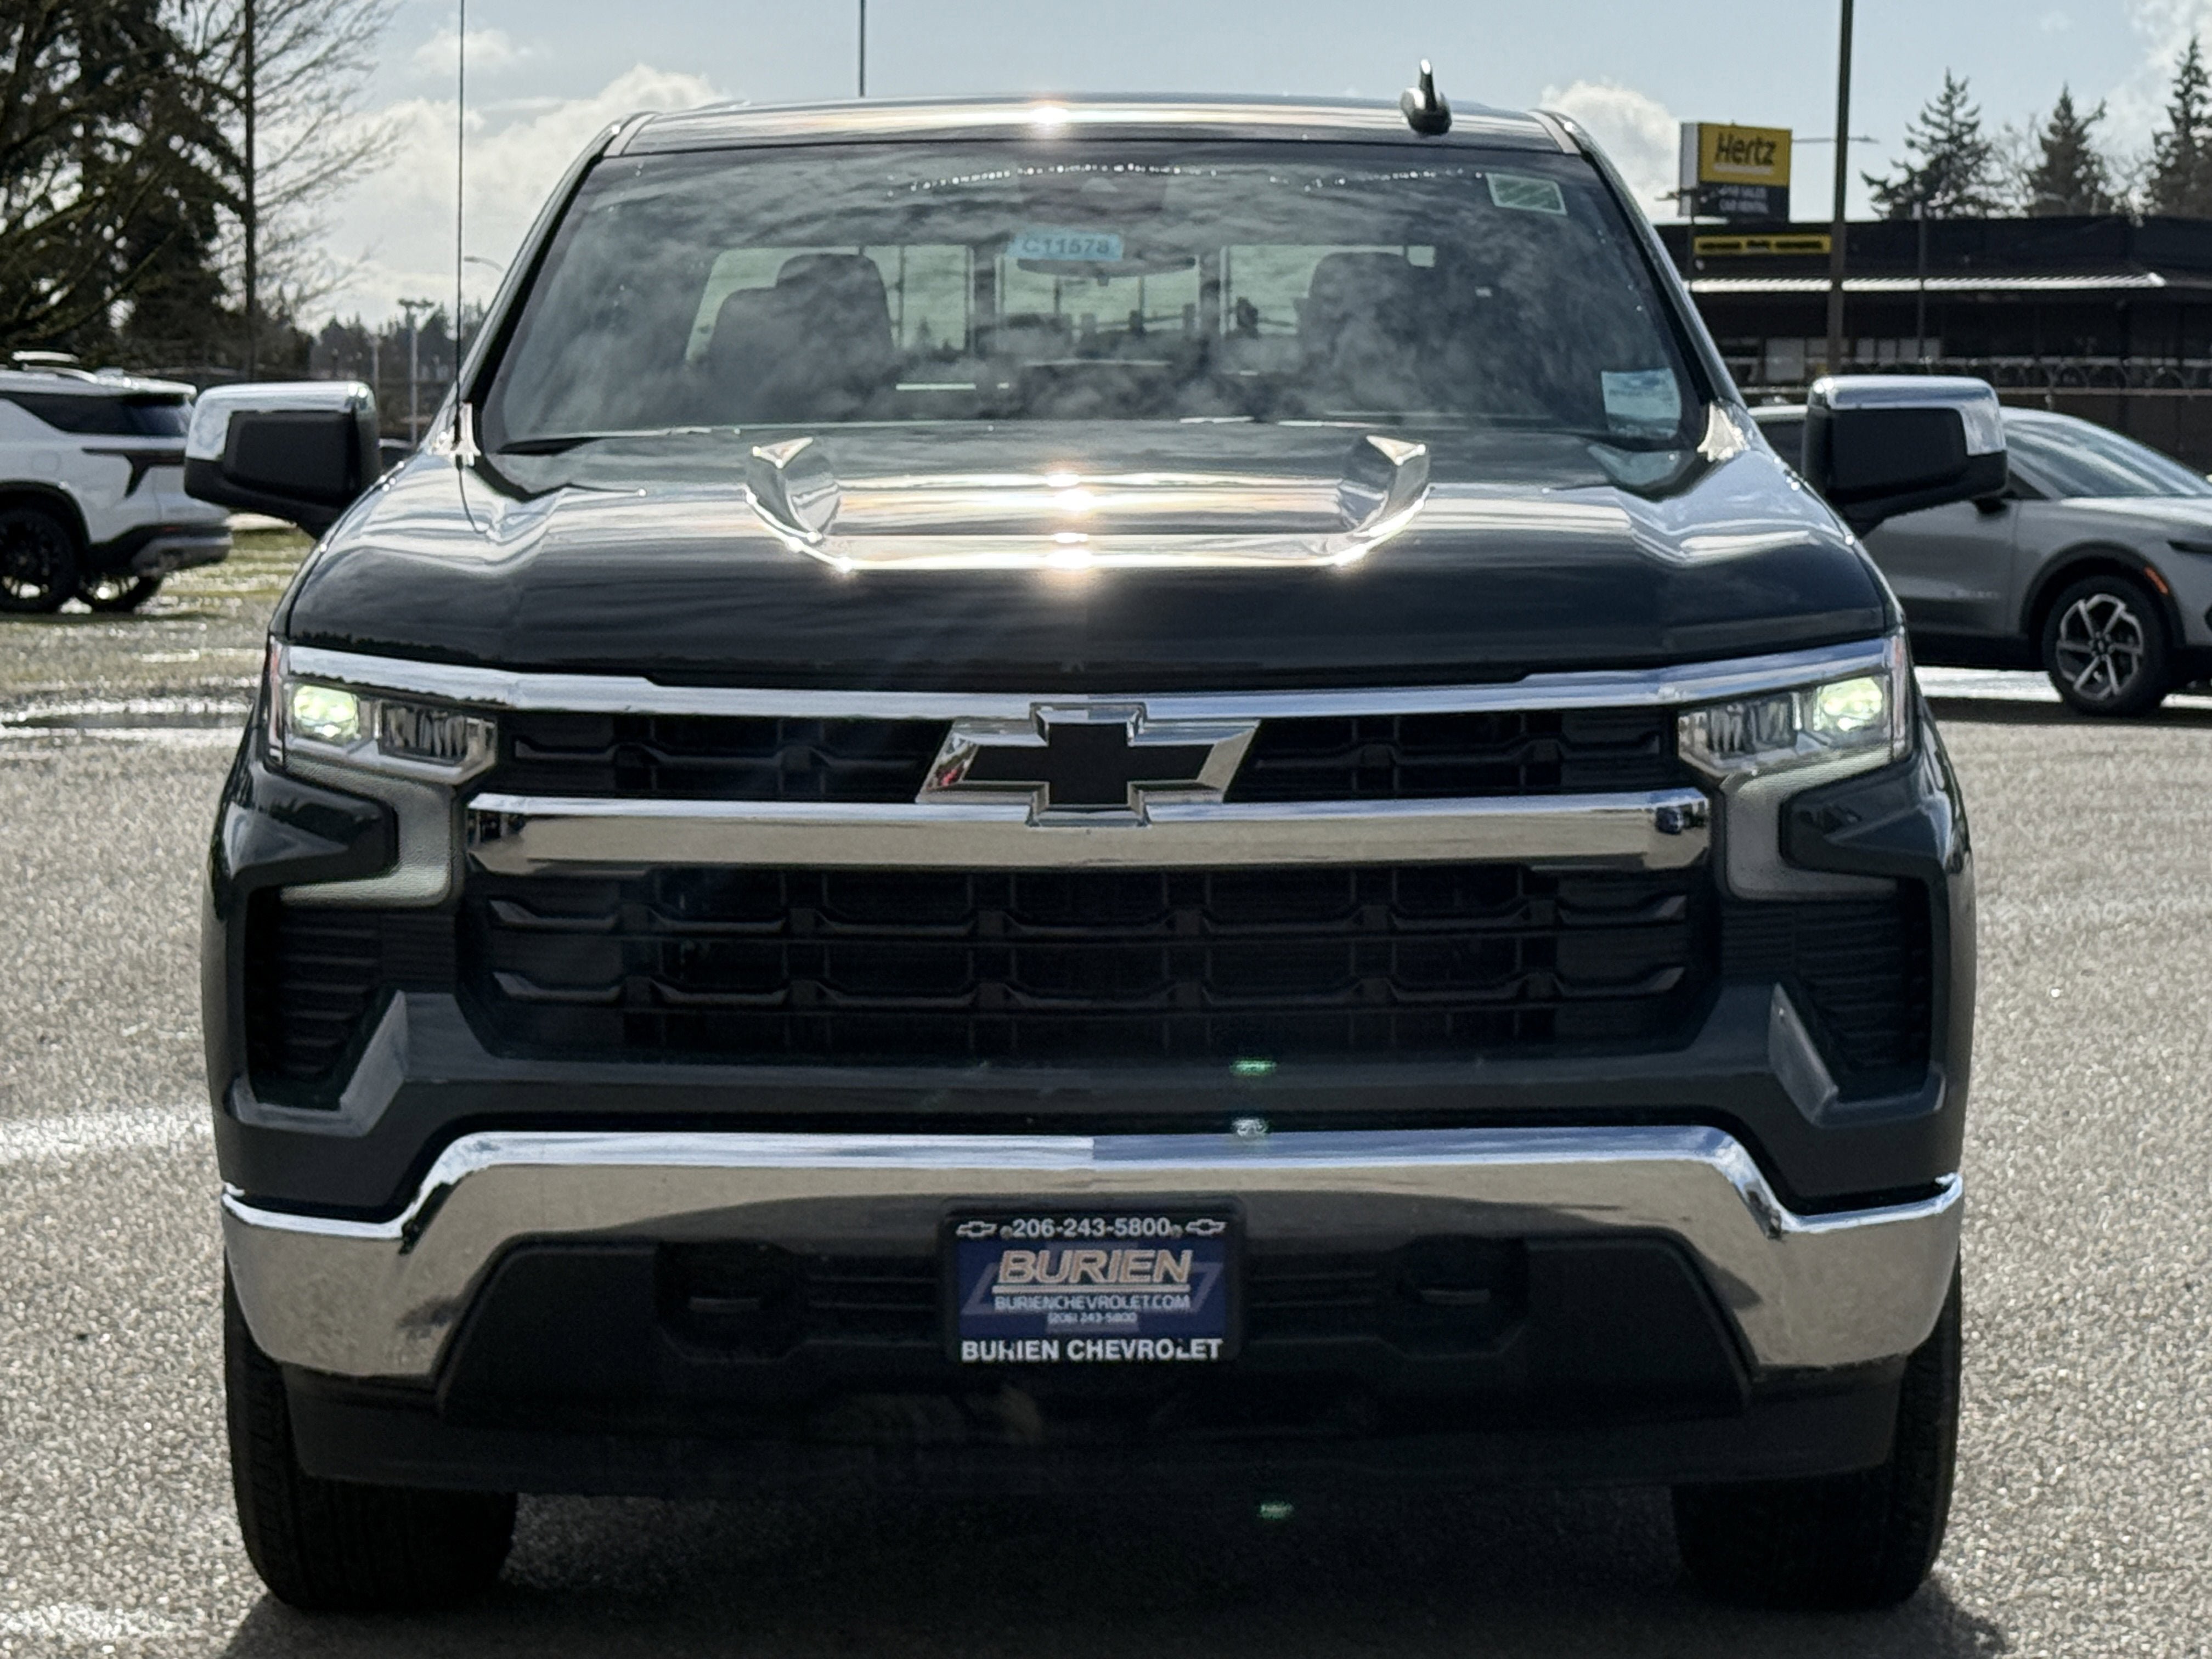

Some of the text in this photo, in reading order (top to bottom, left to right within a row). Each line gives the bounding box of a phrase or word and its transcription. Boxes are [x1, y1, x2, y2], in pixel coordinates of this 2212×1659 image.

[1715, 132, 1776, 165] Hertz
[1012, 1217, 1171, 1238] 206-243-5800
[998, 1249, 1193, 1283] BURIEN
[994, 1294, 1191, 1311] BURIENCHEVROLET.COM
